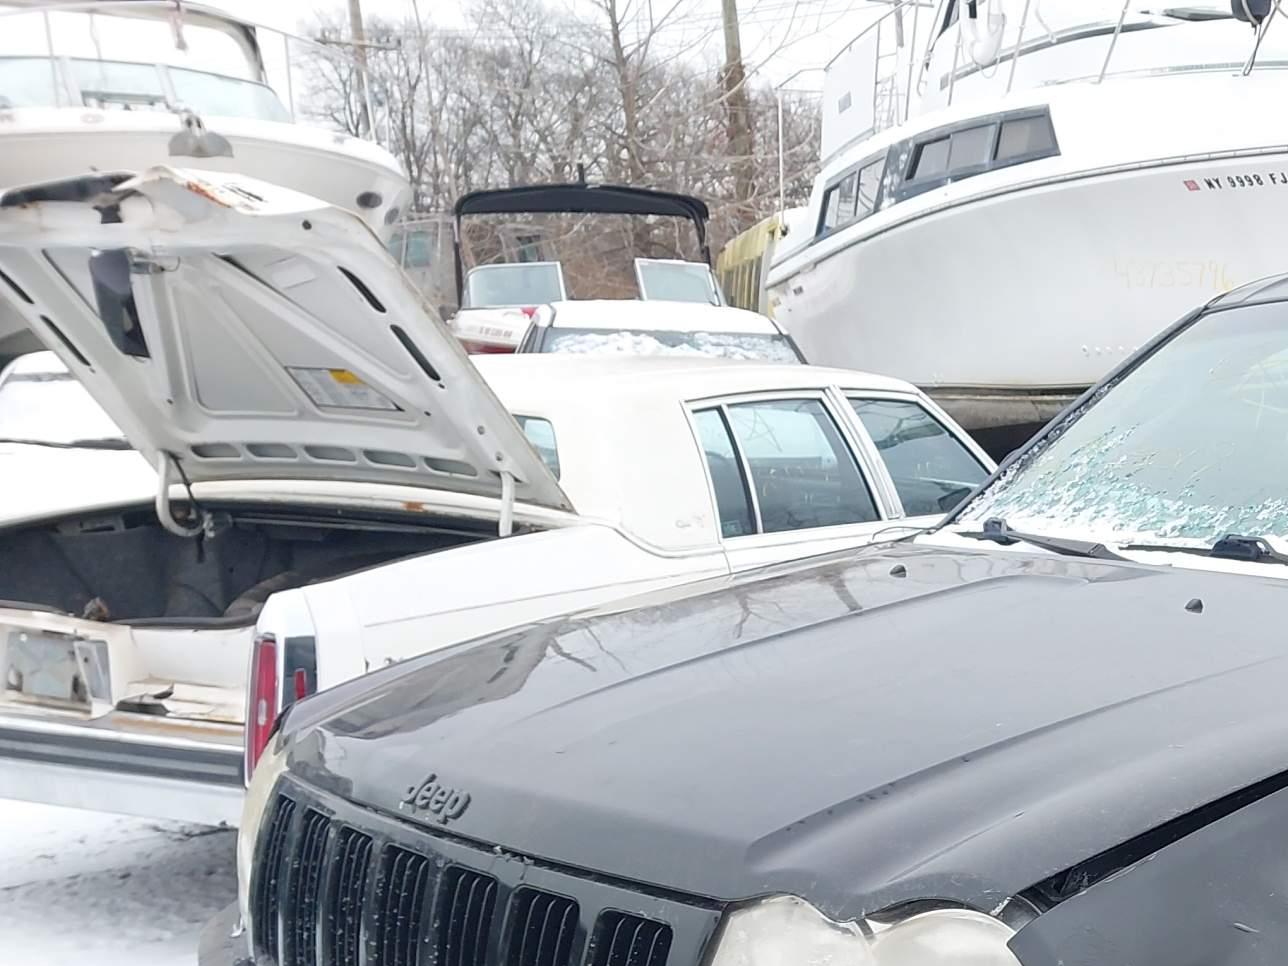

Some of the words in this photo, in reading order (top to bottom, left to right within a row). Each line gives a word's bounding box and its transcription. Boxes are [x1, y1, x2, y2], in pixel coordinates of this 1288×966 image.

[1203, 177, 1223, 190] NY
[1226, 174, 1265, 188] 9998
[1268, 171, 1288, 185] FJ
[402, 772, 473, 826] Jeep
